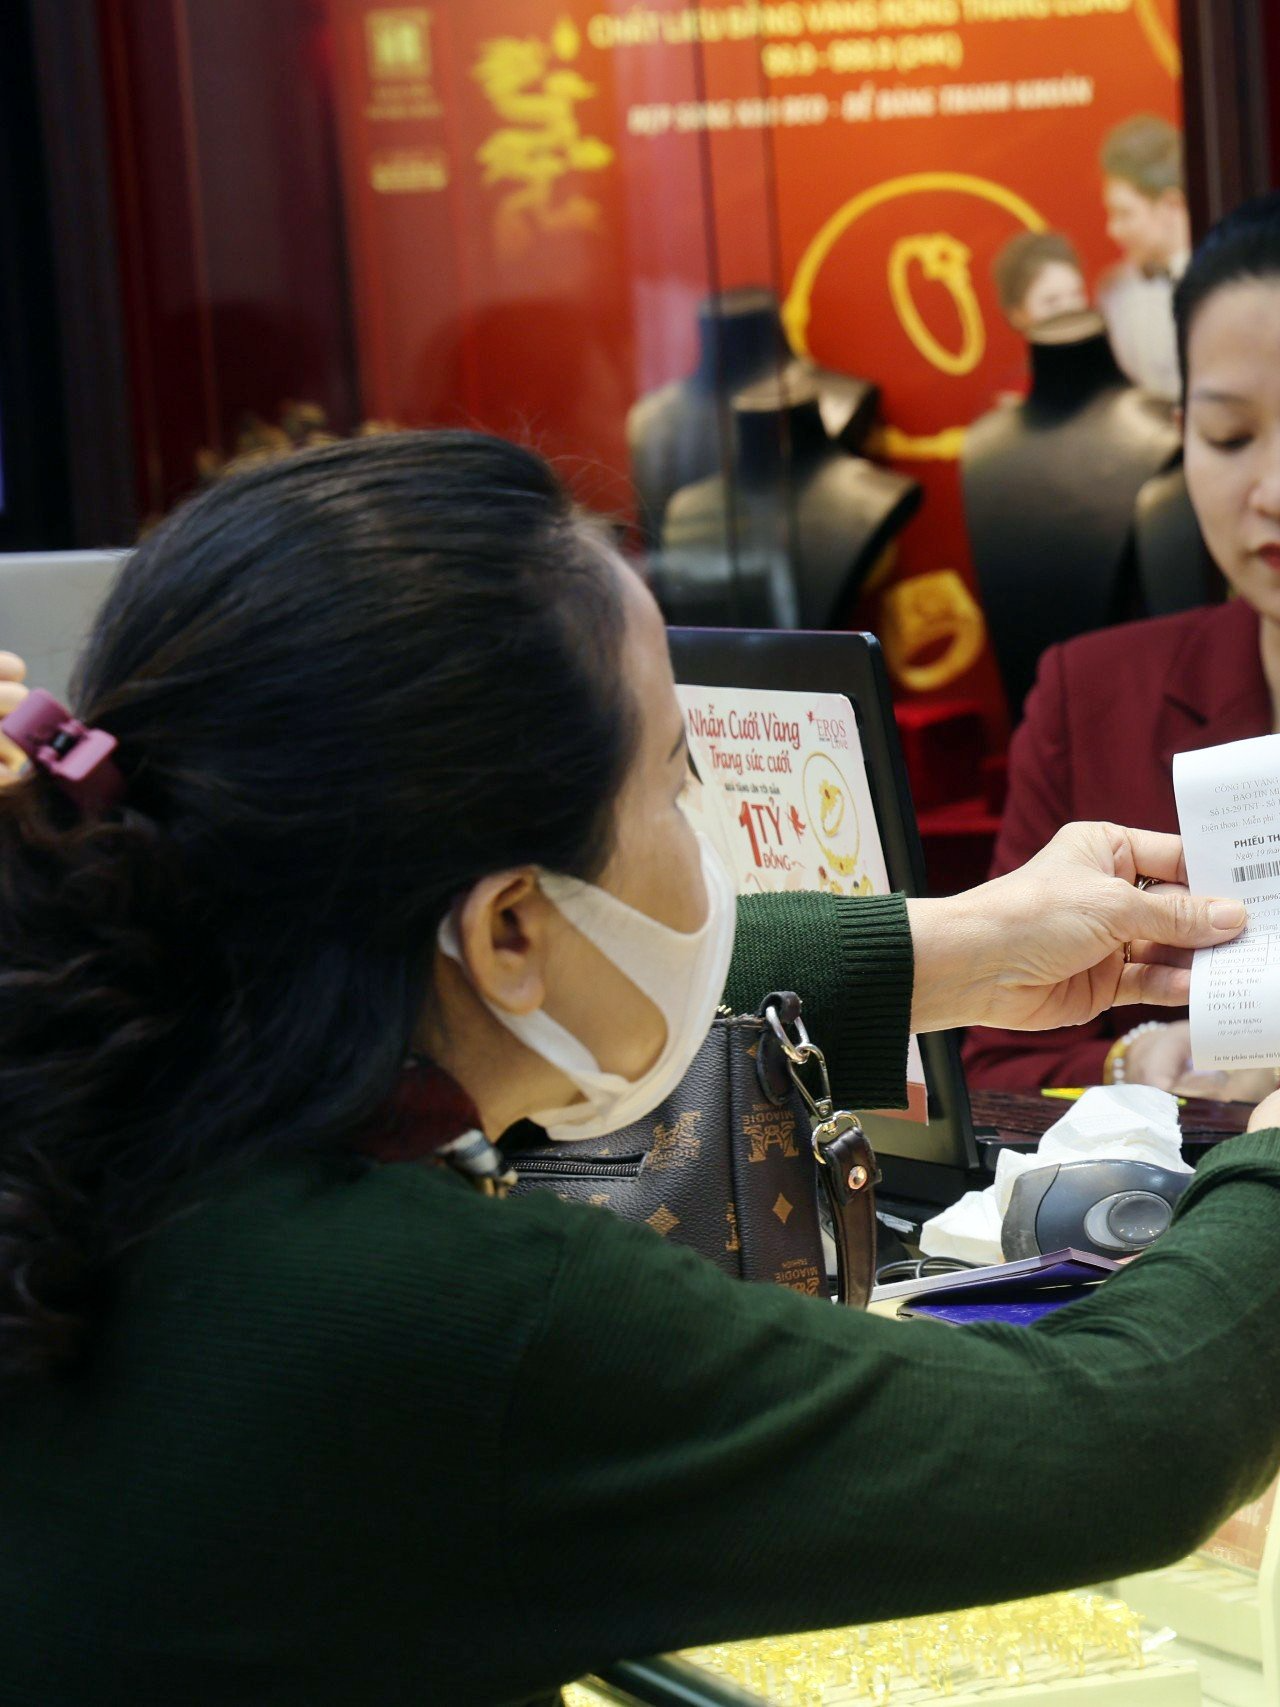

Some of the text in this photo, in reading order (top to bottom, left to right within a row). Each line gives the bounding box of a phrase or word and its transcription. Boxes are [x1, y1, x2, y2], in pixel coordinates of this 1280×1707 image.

[688, 704, 800, 750] Nhẫn Cưới Vàng
[709, 745, 792, 776] Trang sức cưới
[739, 796, 783, 868] 1 TỶ
[1233, 834, 1265, 849] PHIẾU
[763, 847, 792, 872] ĐỒNG
[742, 1110, 795, 1125] MIAODIE
[775, 1266, 818, 1283] MIAODIE
